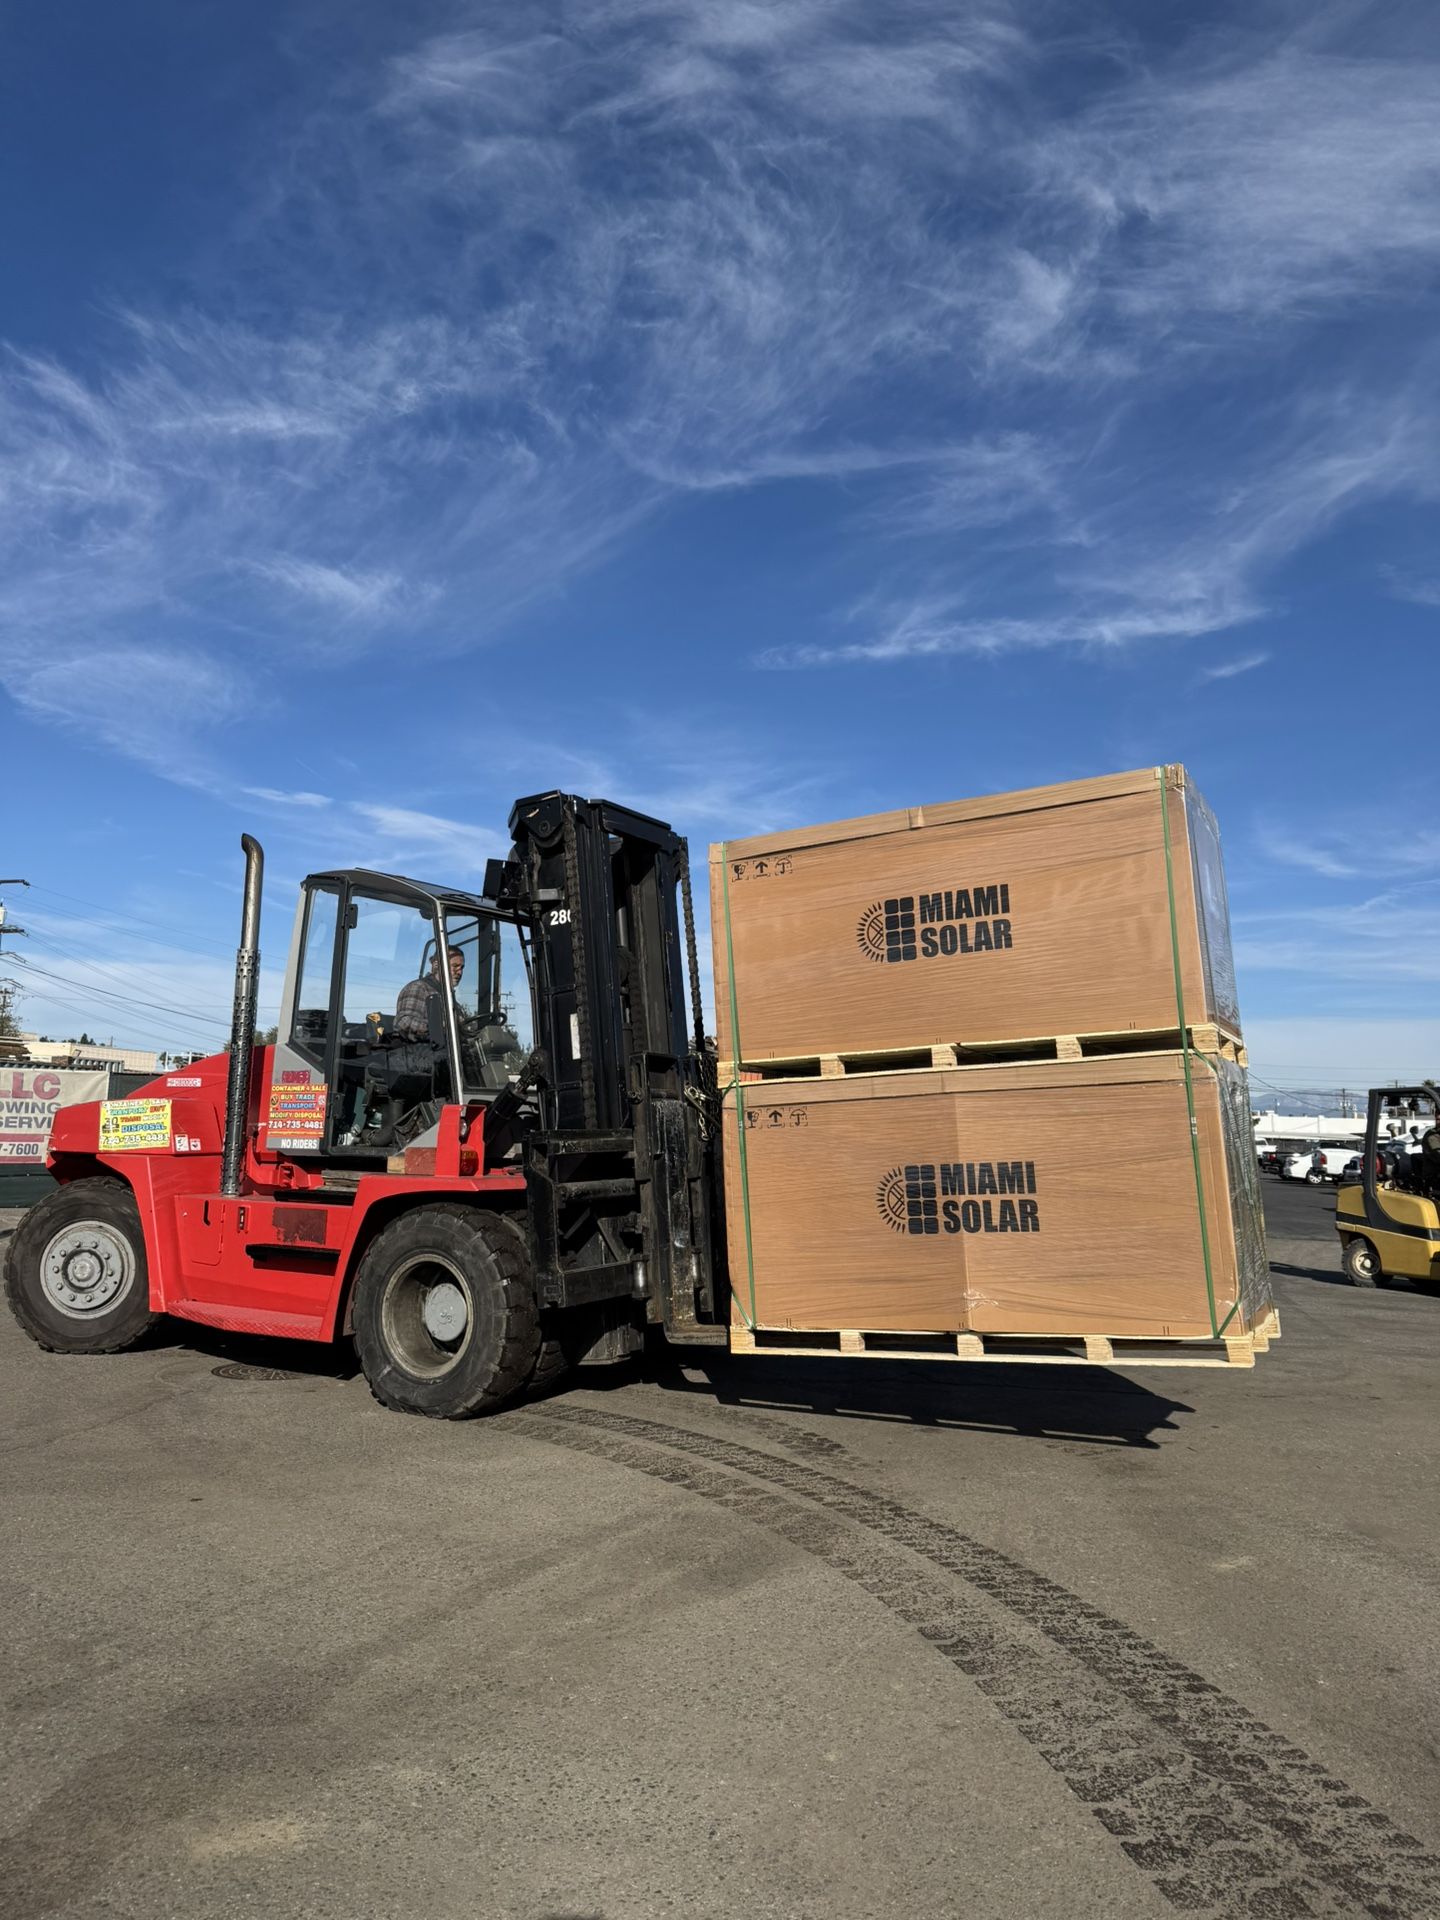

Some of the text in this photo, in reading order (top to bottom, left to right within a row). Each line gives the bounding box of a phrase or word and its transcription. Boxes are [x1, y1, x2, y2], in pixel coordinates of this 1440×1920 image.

[919, 884, 1010, 924] MIAMI
[920, 919, 1013, 958] SOLAR
[0, 1072, 61, 1099] LC
[0, 1102, 61, 1114] WING
[121, 1122, 167, 1133] DISPOSAL
[281, 1139, 318, 1149] NO RIDERS
[940, 1161, 1036, 1196] MIAMI
[942, 1199, 1040, 1234] SOLAR
